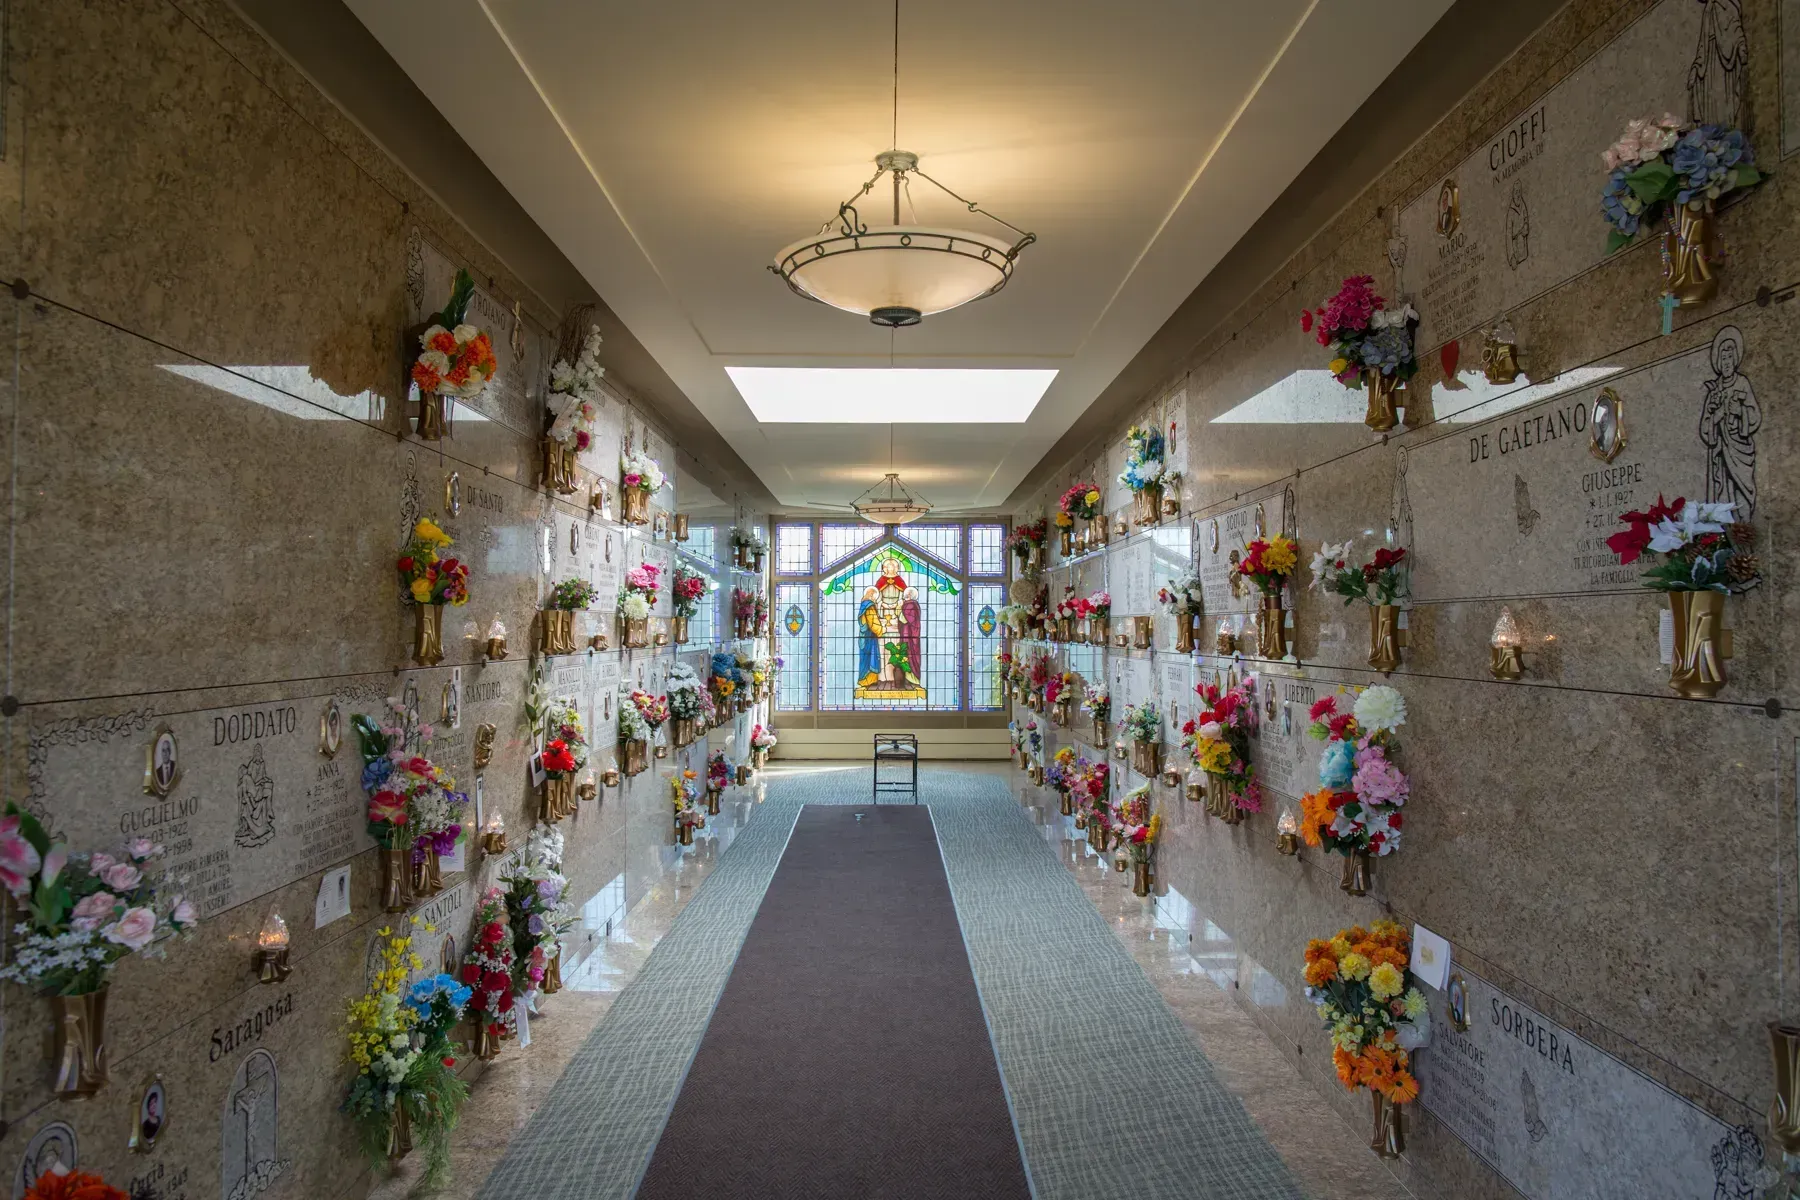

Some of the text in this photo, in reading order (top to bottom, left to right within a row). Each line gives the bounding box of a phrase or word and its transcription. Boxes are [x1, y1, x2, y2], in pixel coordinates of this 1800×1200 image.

[1489, 106, 1547, 172] CIOFFI
[1439, 233, 1464, 260] MARIO
[1470, 402, 1587, 463] DE GAETANO
[1582, 463, 1642, 493] GIUSEPPE
[1582, 554, 1621, 569] RICORDIAM
[465, 681, 501, 704] SANTORO
[1285, 683, 1316, 706] LIBERTO
[214, 707, 296, 747] DODDATO
[317, 762, 339, 782] ANNA
[120, 797, 198, 834] GUGLIELMO
[425, 888, 462, 924] SANTOLI
[209, 992, 293, 1063] Saragosa
[1439, 1022, 1485, 1068] SALVATORE
[1491, 997, 1576, 1076] SORBERA
